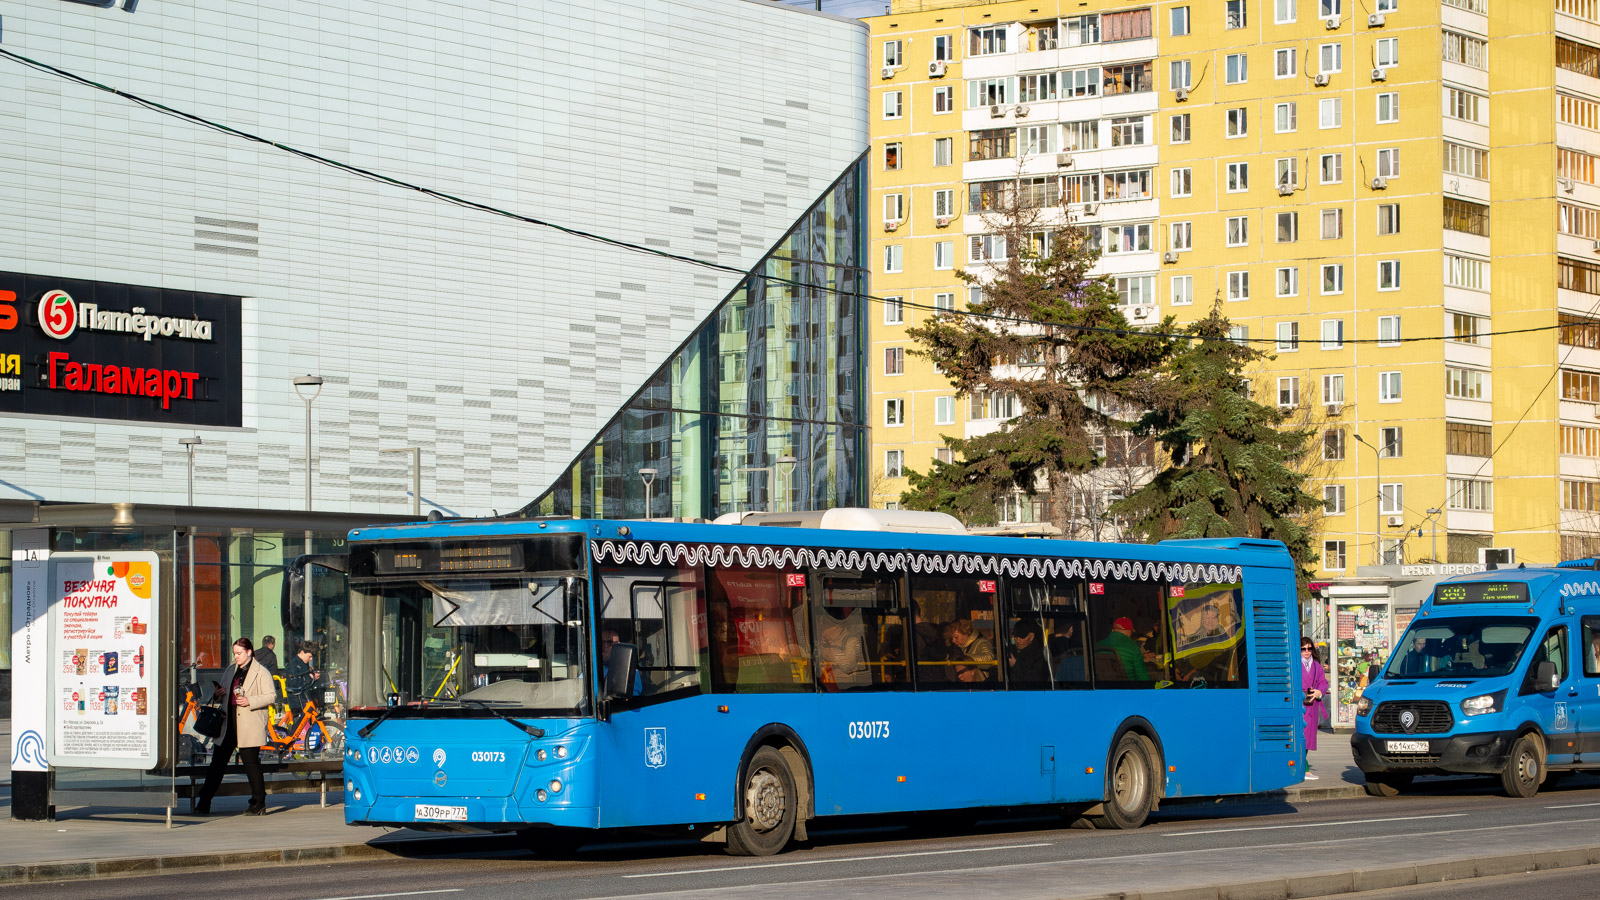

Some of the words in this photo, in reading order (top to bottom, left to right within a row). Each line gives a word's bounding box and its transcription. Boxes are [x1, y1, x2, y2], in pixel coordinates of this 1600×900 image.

[79, 302, 212, 341] Пятёрочка
[49, 351, 200, 410] Галамарт
[1401, 565, 1436, 576] ПРЕССА
[1440, 564, 1487, 575] ПРЕССА
[63, 580, 116, 593] ВЕЗУЧАЯ
[63, 595, 117, 608] ПОКУПКА
[849, 721, 890, 739] 030173
[472, 751, 505, 763] 030173
[452, 807, 465, 816] 777
